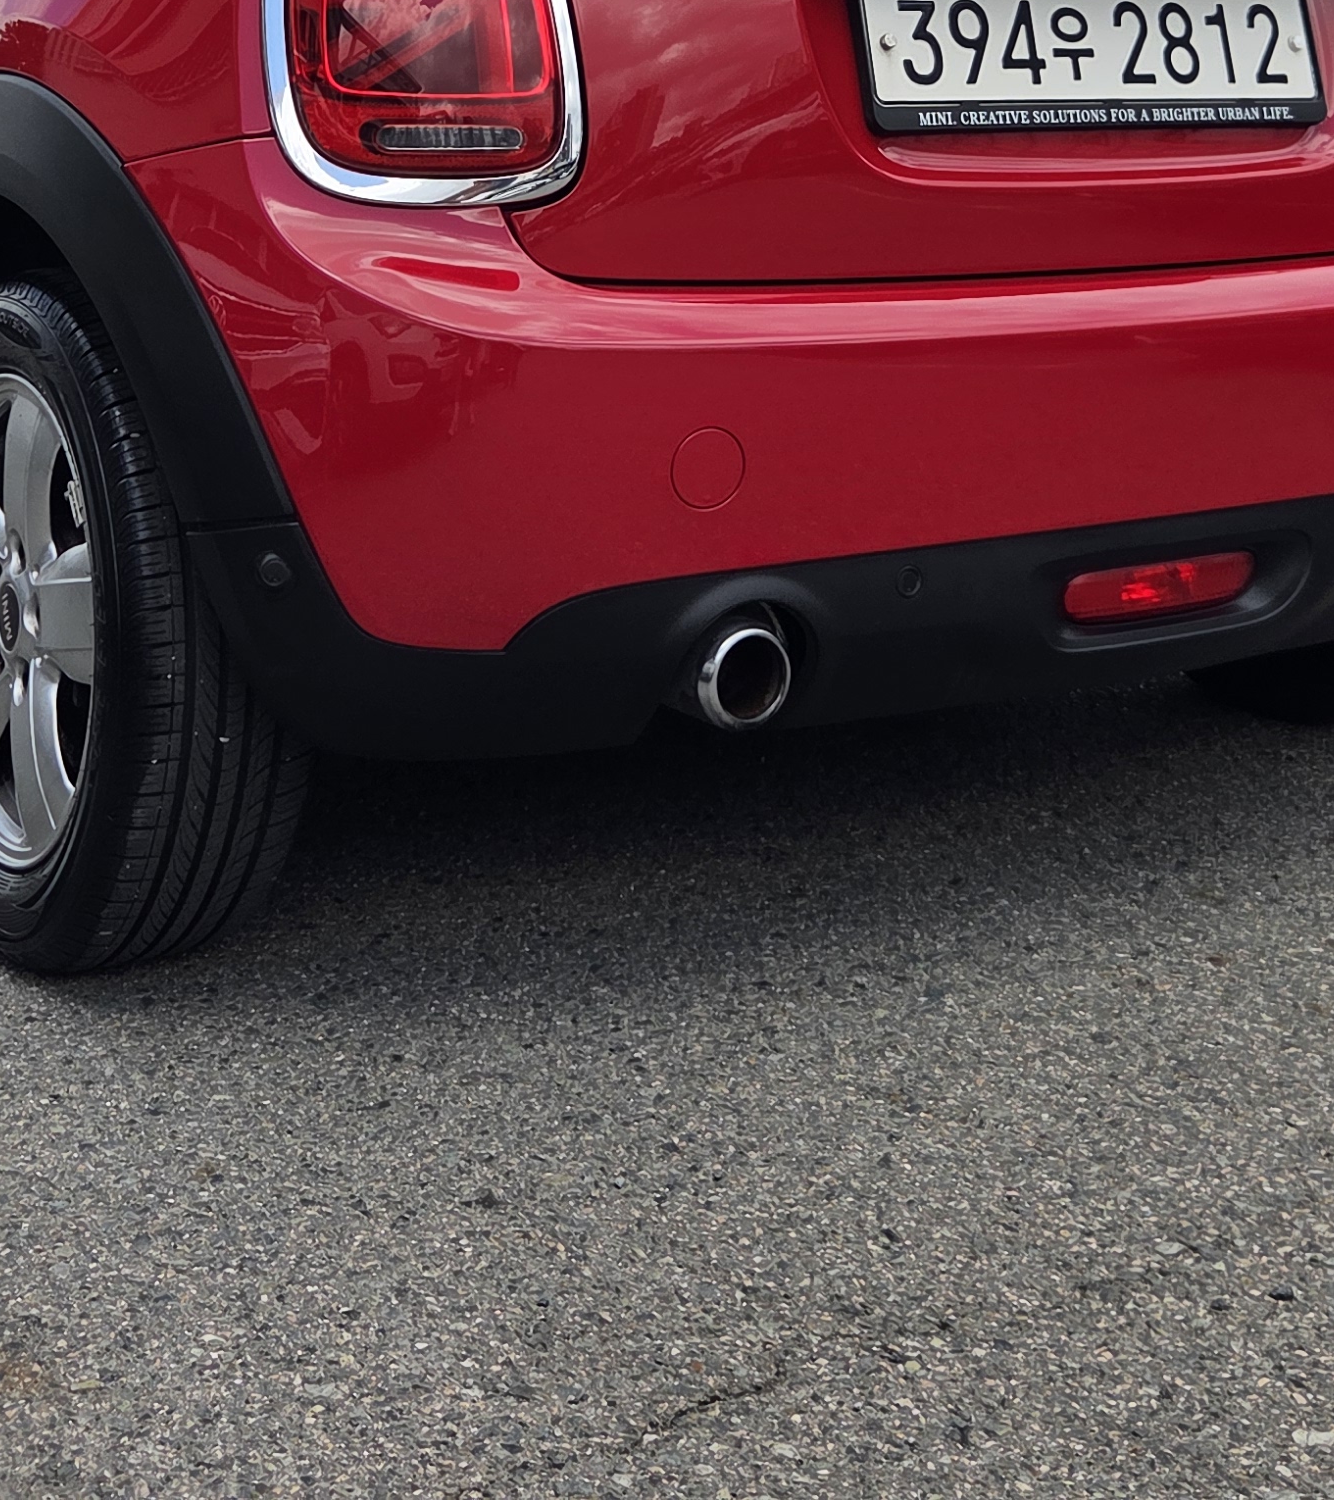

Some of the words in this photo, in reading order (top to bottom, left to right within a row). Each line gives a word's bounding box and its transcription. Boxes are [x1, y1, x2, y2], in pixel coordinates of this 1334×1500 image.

[896, 0, 1095, 86] 394우
[1113, 1, 1289, 85] 2812
[919, 111, 958, 126] MINI.
[961, 110, 1030, 125] CREATIVE
[1033, 109, 1108, 124] SOLUTIONS
[1111, 108, 1138, 123] FOR
[1140, 108, 1151, 122] A
[1152, 107, 1217, 121] BRIGHTER
[1218, 106, 1260, 121] URBAN
[1, 592, 13, 641] MINI
